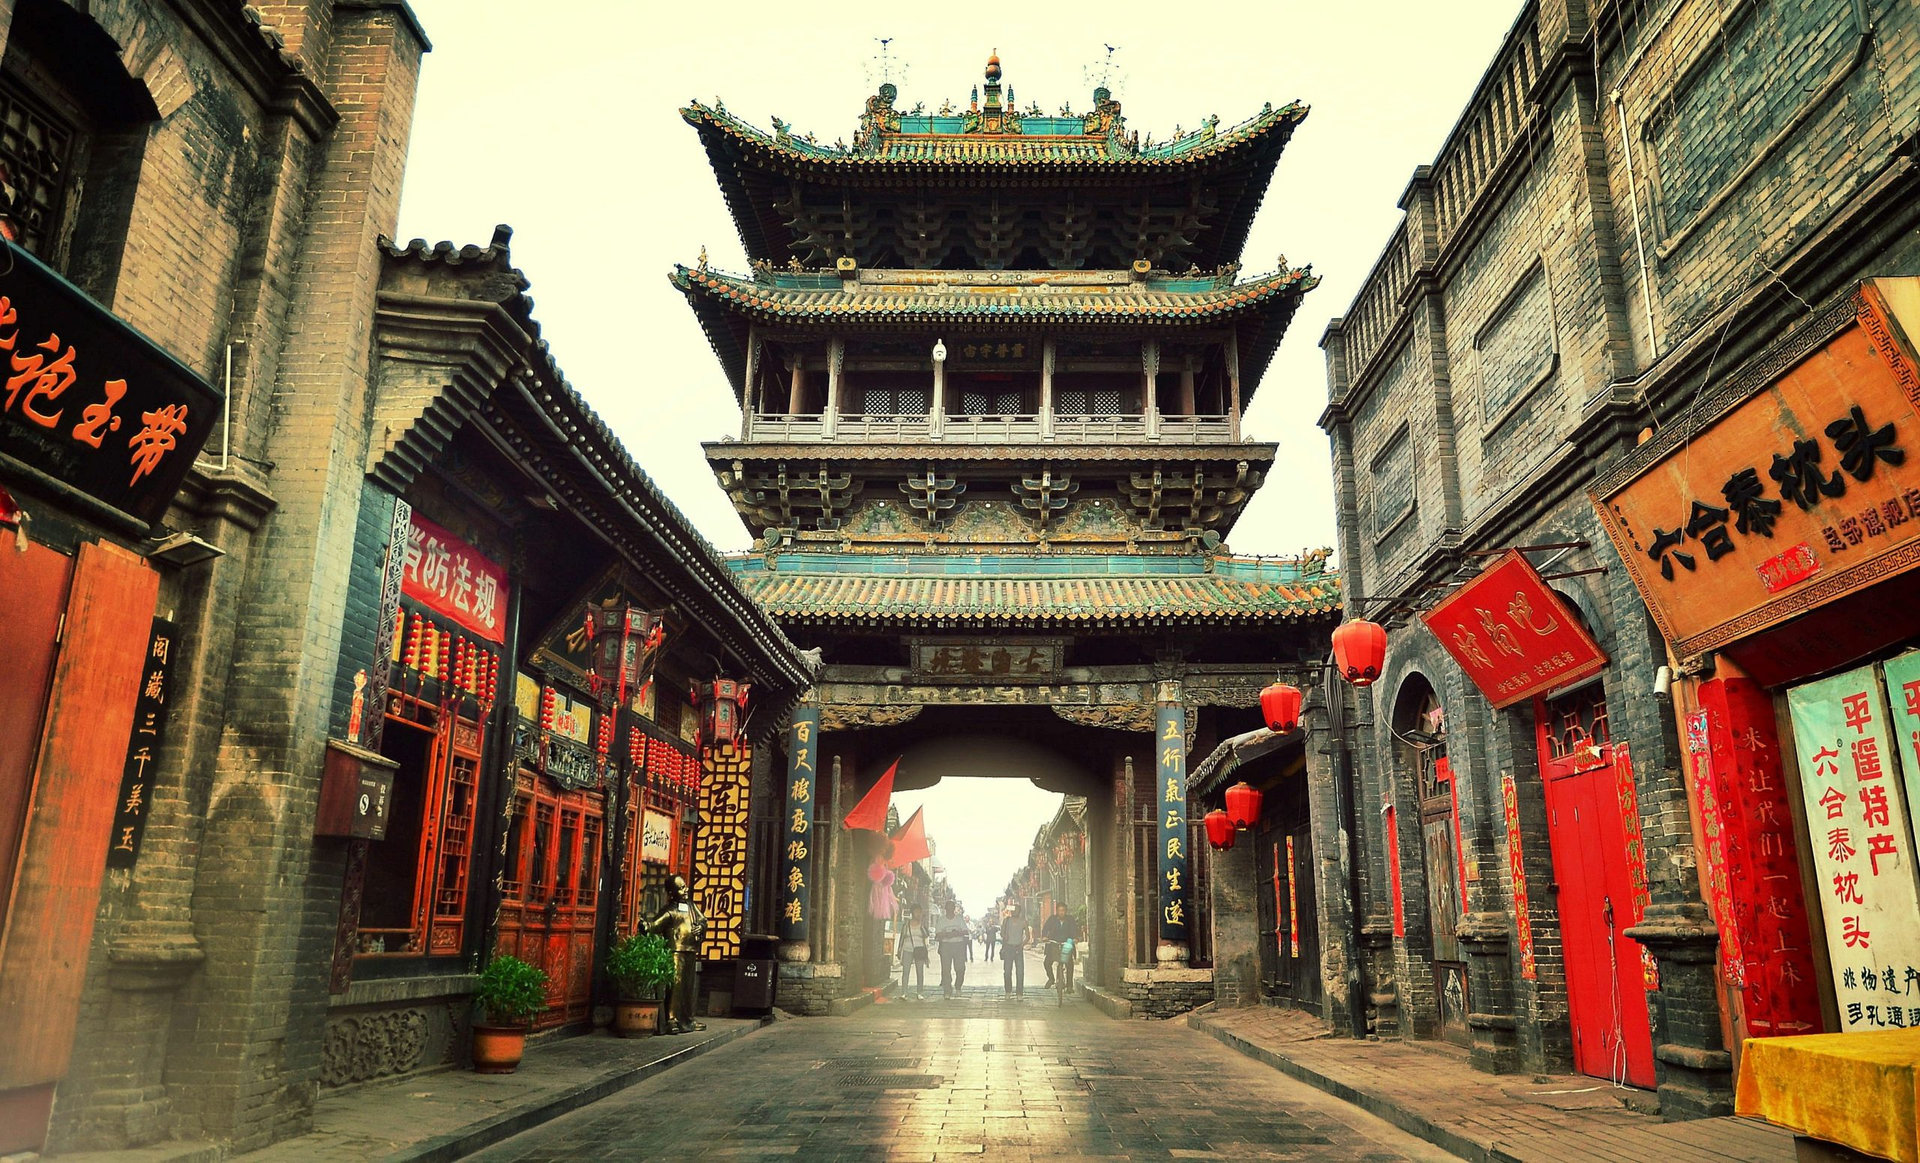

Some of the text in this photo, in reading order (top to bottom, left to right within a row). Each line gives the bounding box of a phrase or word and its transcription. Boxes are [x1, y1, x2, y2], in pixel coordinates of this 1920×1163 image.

[1648, 405, 1905, 581] 六合泰枕头
[1811, 746, 1870, 949] 六合泰枕头
[1842, 691, 1897, 877] 平遥特产
